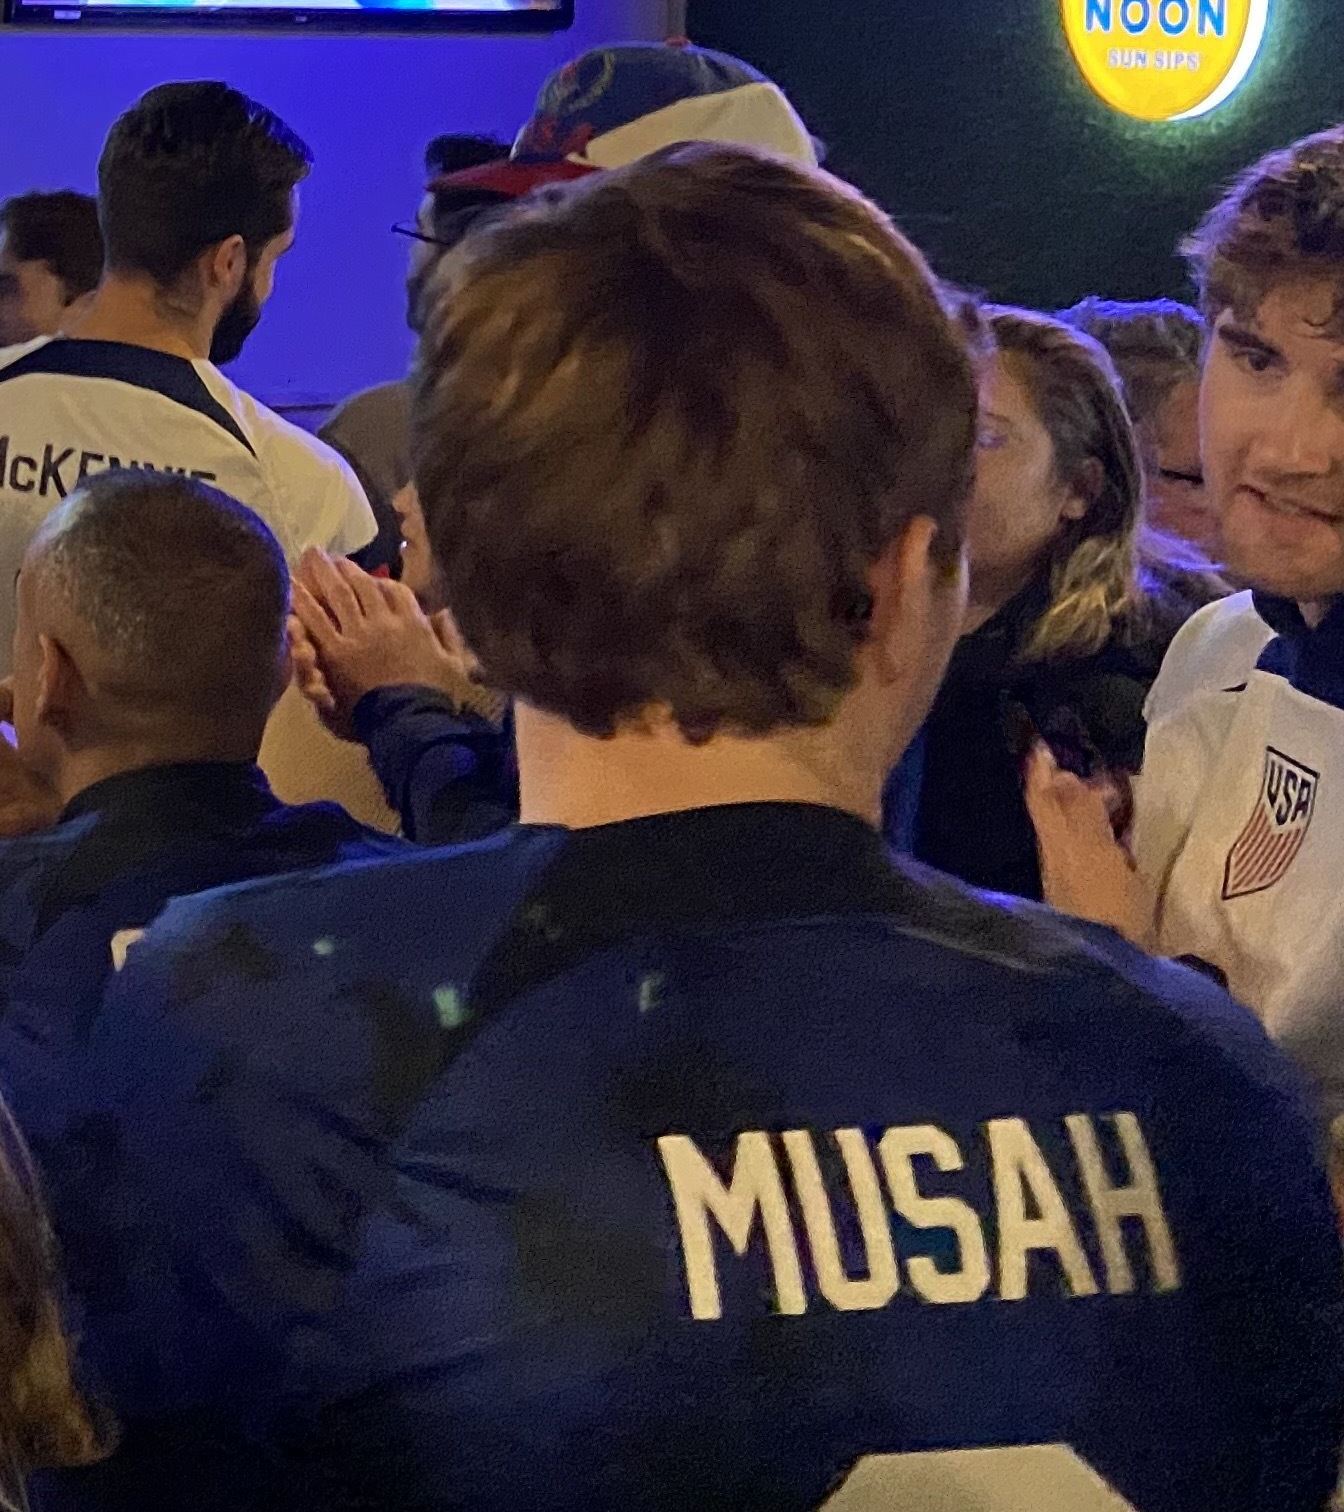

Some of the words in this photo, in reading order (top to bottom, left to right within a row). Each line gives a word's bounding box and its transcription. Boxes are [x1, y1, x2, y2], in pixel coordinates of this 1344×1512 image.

[1108, 49, 1148, 69] SUN
[1154, 50, 1200, 72] SIPS
[1267, 759, 1312, 826] USA
[656, 1110, 1183, 1321] MUSAH
